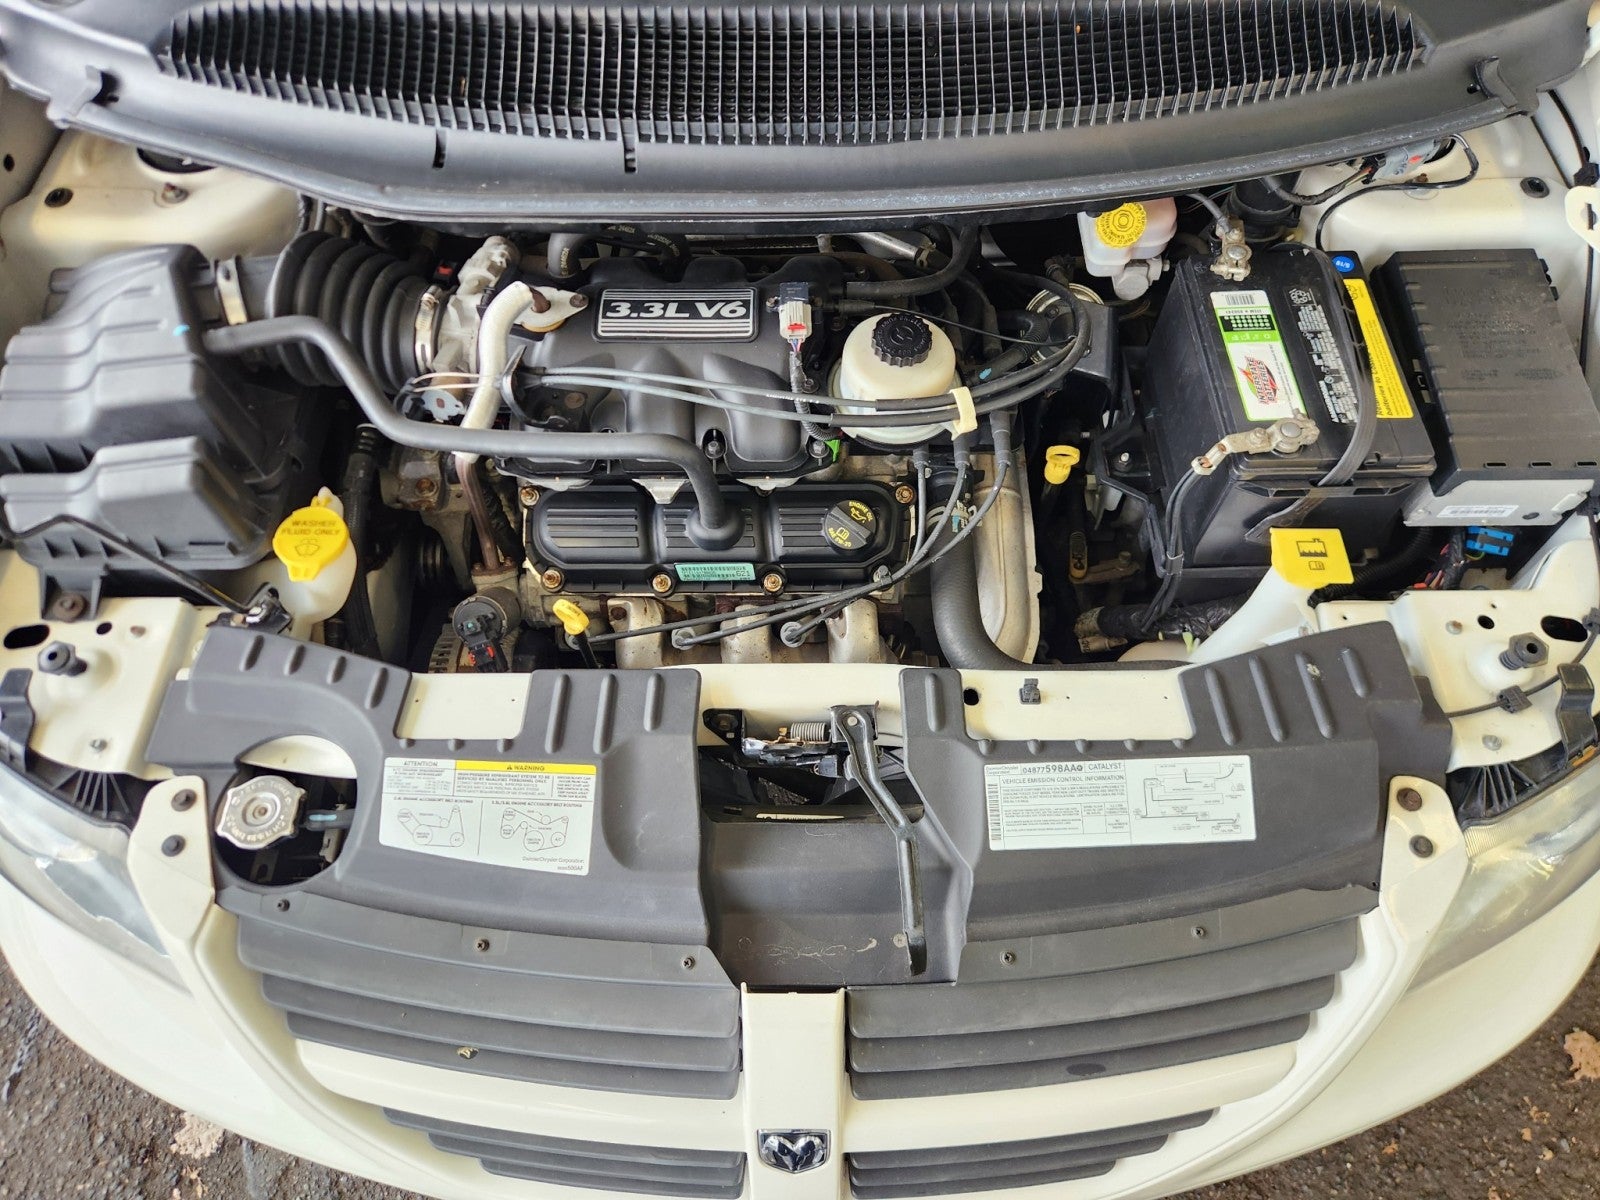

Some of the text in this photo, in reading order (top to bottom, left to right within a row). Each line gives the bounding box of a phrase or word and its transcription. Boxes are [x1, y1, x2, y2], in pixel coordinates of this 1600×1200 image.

[606, 301, 747, 318] 3.3L V6
[1246, 357, 1270, 404] INTERSTATE
[1257, 360, 1277, 402] BATTERIES
[849, 501, 869, 513] ENGINE
[281, 527, 341, 536] FLUID ONLY
[513, 764, 546, 772] WARNING
[1088, 762, 1122, 771] CATALYST
[1084, 774, 1125, 782] INFORMATION
